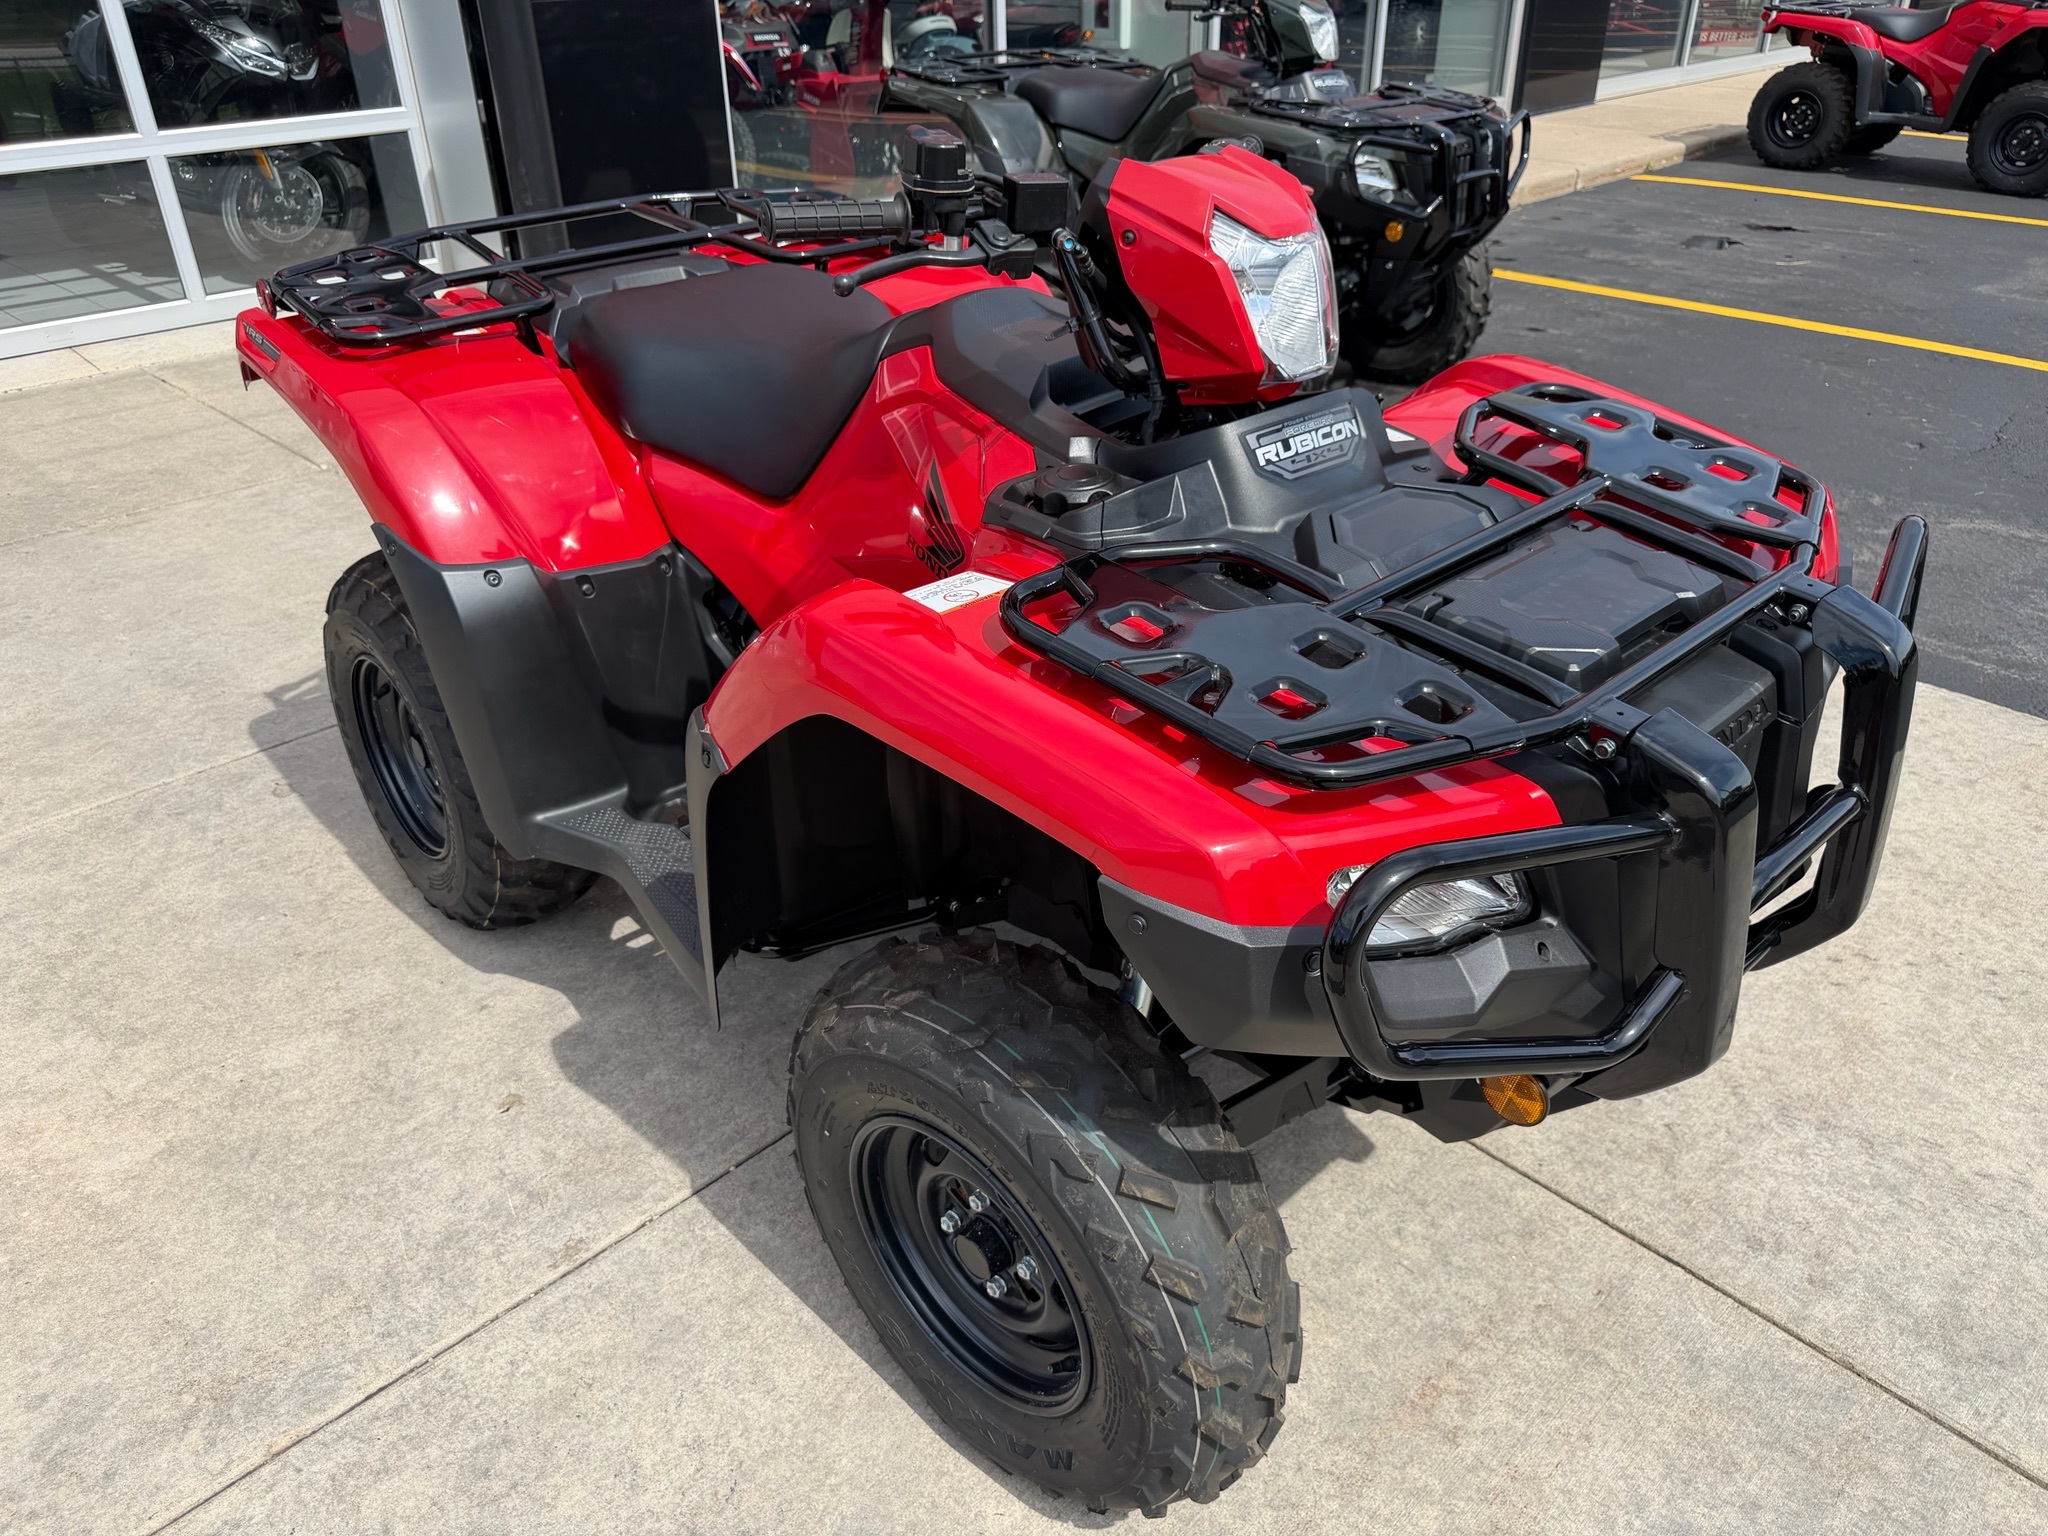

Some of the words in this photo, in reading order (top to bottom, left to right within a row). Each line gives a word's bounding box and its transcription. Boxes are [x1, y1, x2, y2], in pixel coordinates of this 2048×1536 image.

[1709, 31, 1738, 42] BETTER
[246, 325, 263, 345] IRS
[1255, 418, 1359, 467] RUBICON
[1284, 415, 1334, 437] FOREMAN
[906, 531, 950, 580] HOND
[1717, 697, 1772, 748] NDA
[877, 1313, 1074, 1472] MAXXIS
